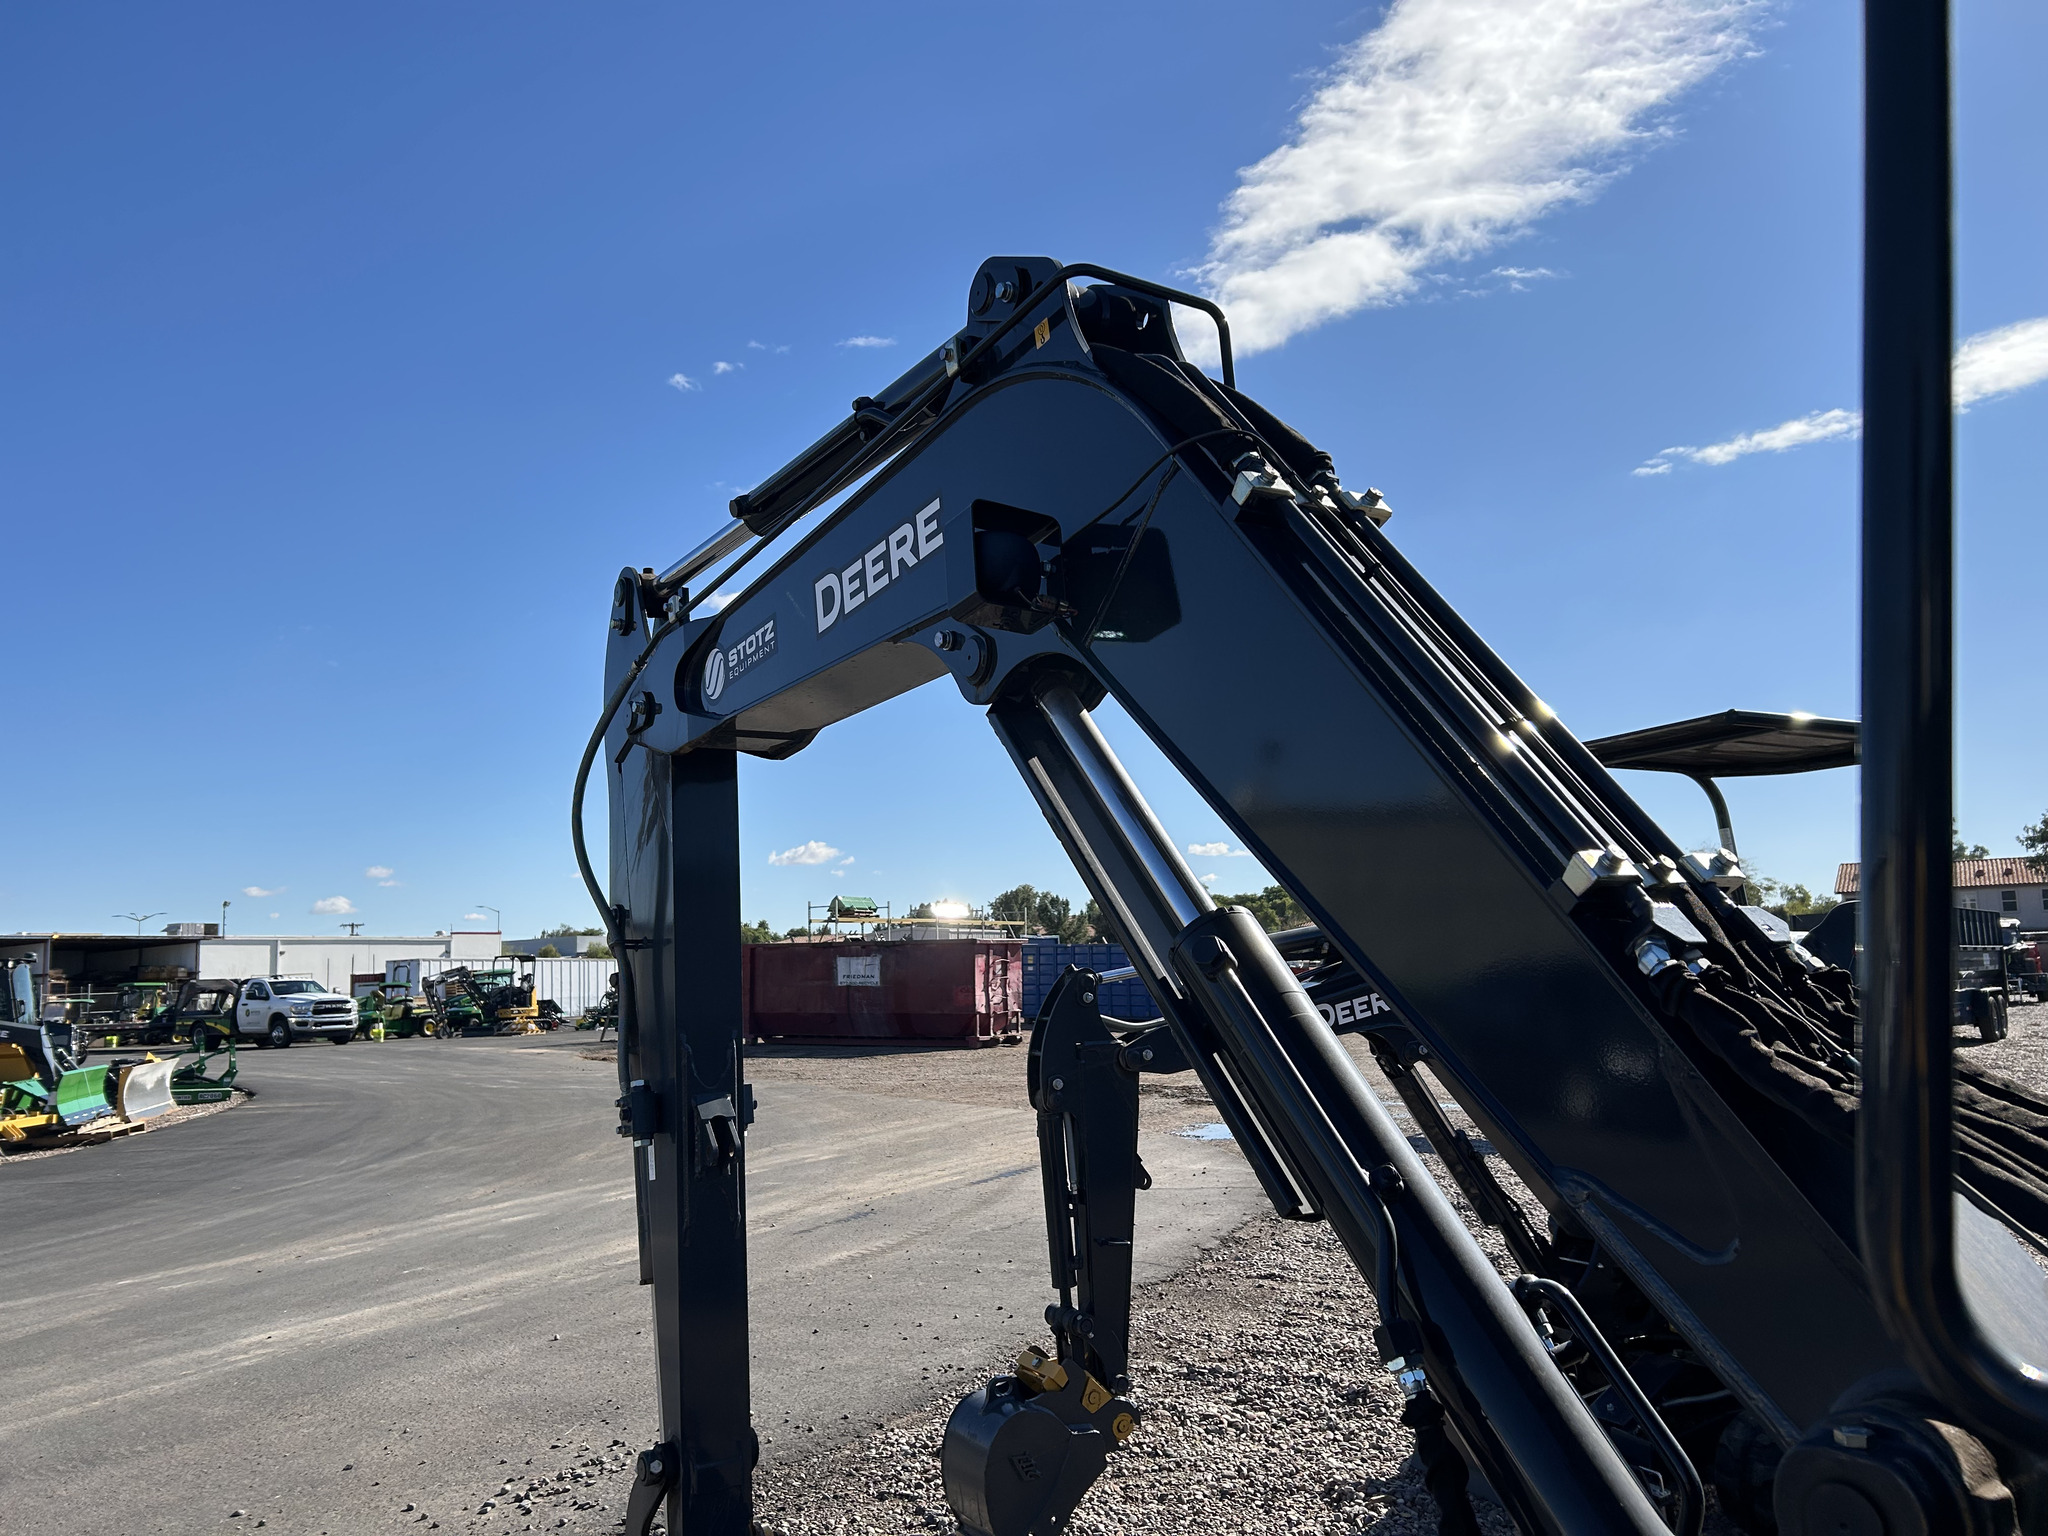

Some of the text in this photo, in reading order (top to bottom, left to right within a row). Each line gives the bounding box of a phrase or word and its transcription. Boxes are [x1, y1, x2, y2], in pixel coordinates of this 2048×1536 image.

[814, 497, 944, 634] DEERE
[728, 619, 775, 667] STOTZ
[729, 641, 775, 680] EQUIPMENT
